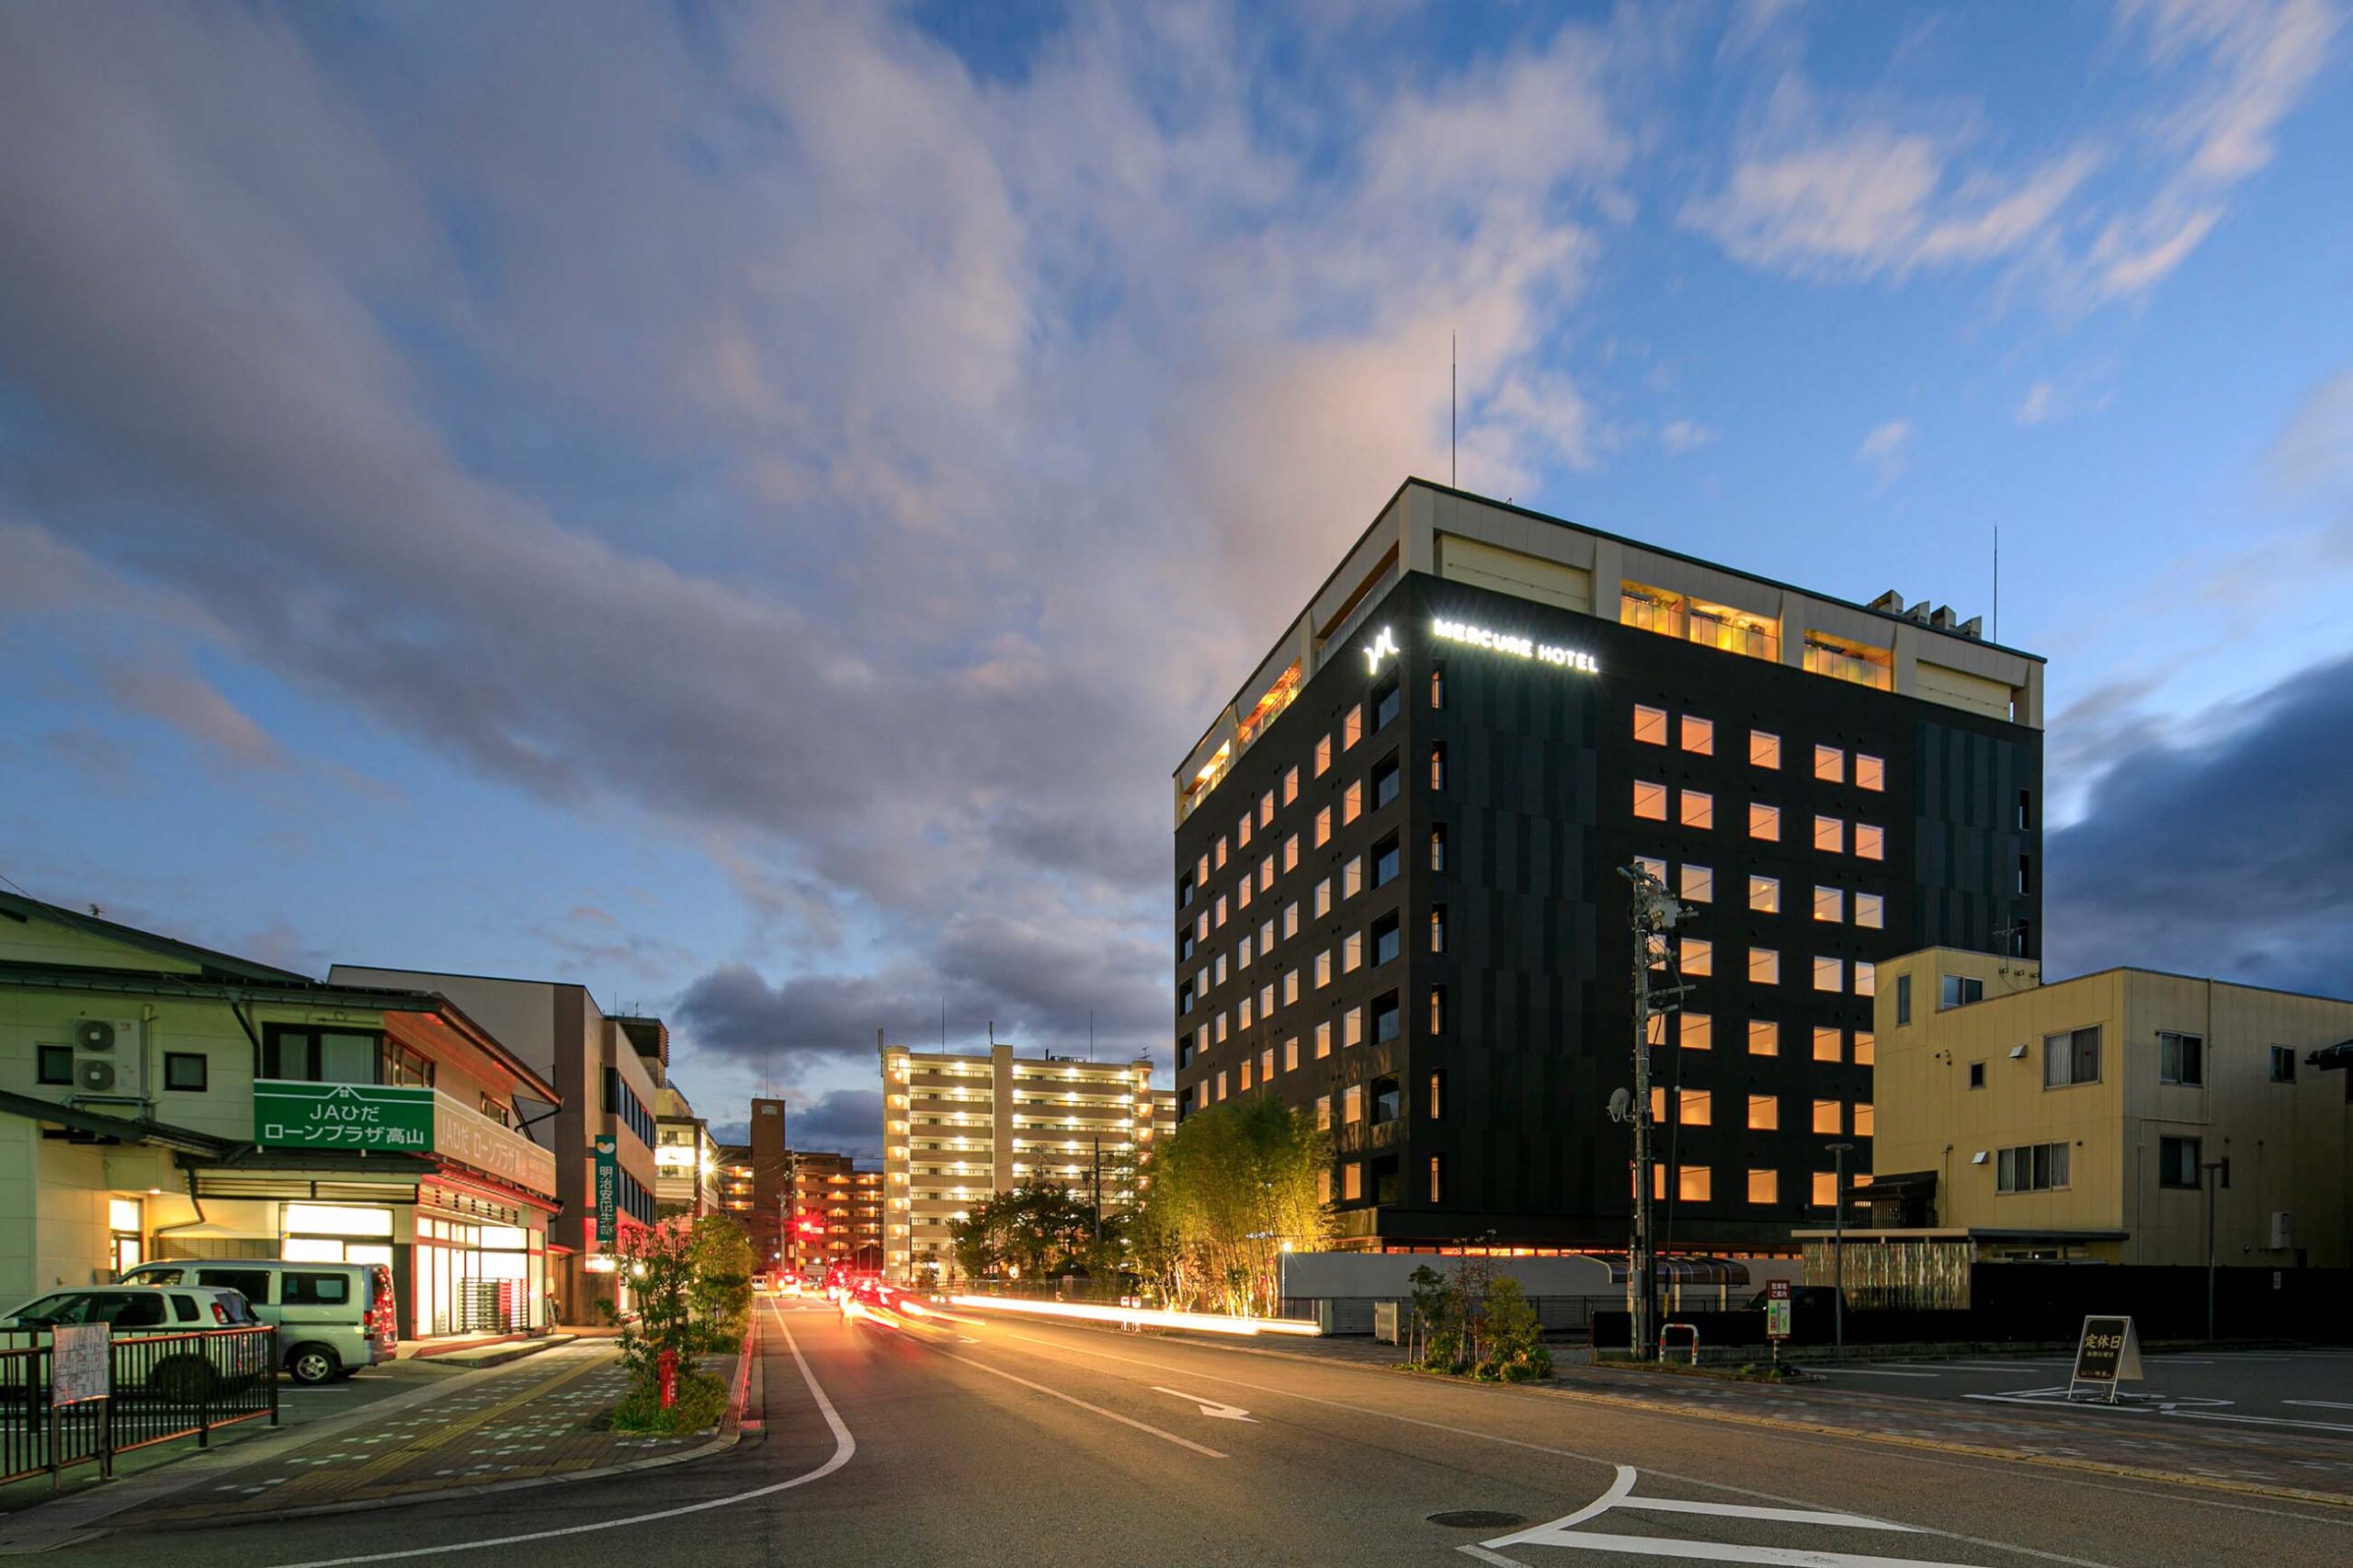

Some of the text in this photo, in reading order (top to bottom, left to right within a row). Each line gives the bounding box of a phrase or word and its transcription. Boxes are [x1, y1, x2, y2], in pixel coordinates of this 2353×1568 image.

[1433, 619, 1599, 674] MERCURE HOTEL
[309, 1104, 380, 1122] JAひだ
[265, 1124, 425, 1145] ローンプラザ高山
[2085, 1334, 2121, 1349] 定休日
